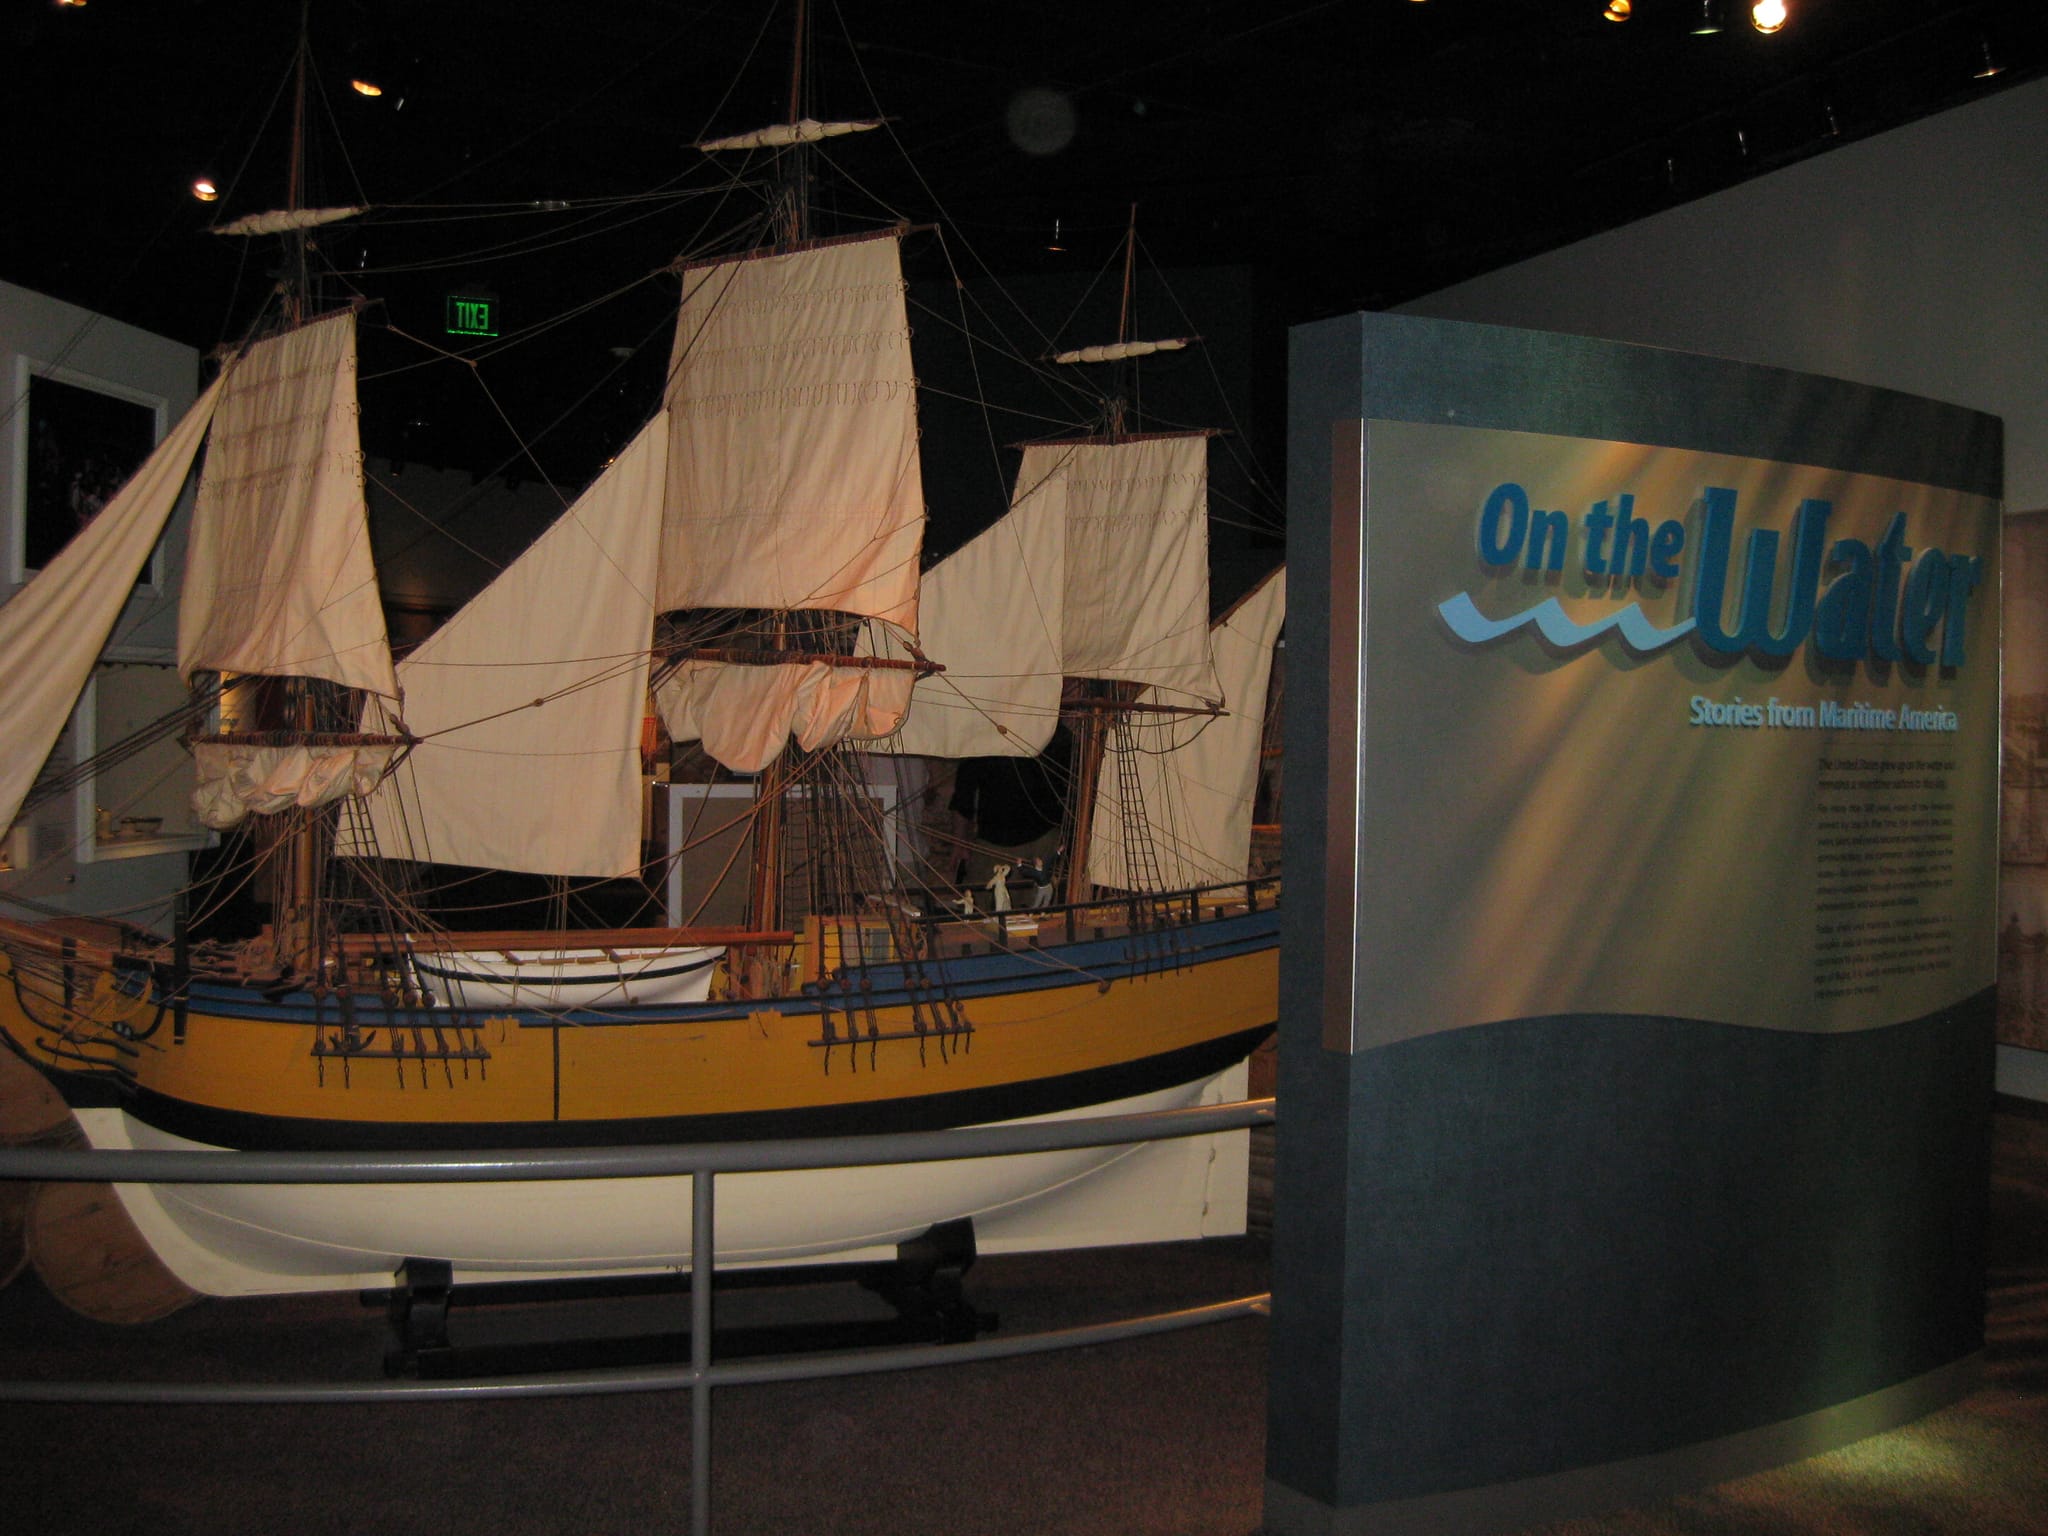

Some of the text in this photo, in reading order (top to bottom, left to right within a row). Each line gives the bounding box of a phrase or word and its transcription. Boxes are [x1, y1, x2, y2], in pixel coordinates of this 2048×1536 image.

[1478, 482, 1980, 667] On the Water
[1689, 695, 1957, 732] Stories from Maritime America
